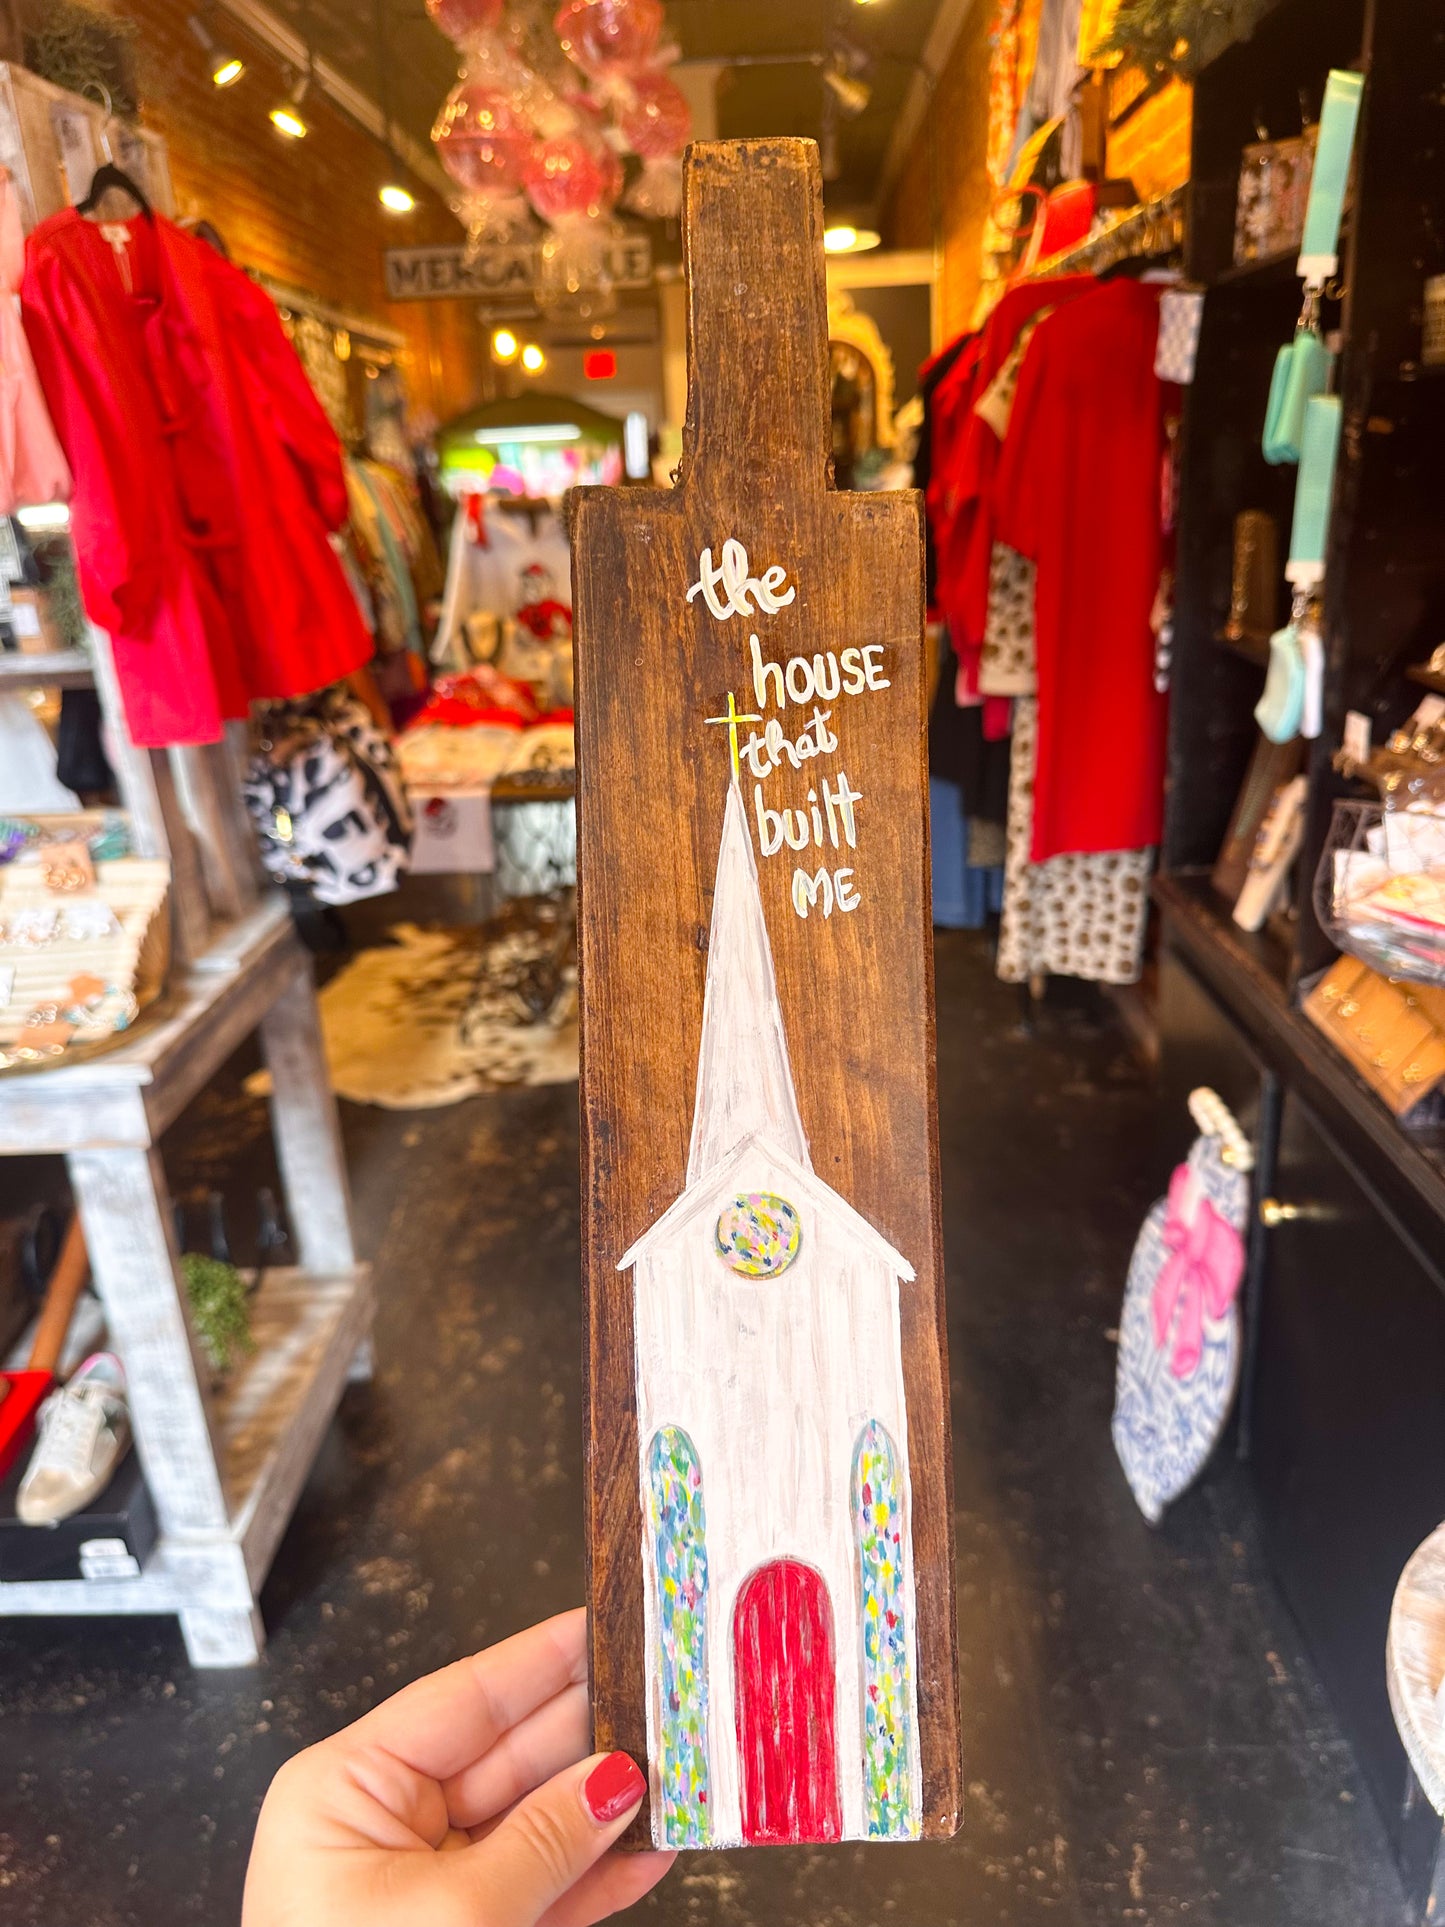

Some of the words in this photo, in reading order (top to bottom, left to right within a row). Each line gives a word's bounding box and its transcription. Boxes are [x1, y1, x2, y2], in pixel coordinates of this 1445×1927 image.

[686, 538, 796, 621] the
[739, 706, 839, 779] that
[754, 771, 864, 858] built
[791, 867, 861, 919] ME
